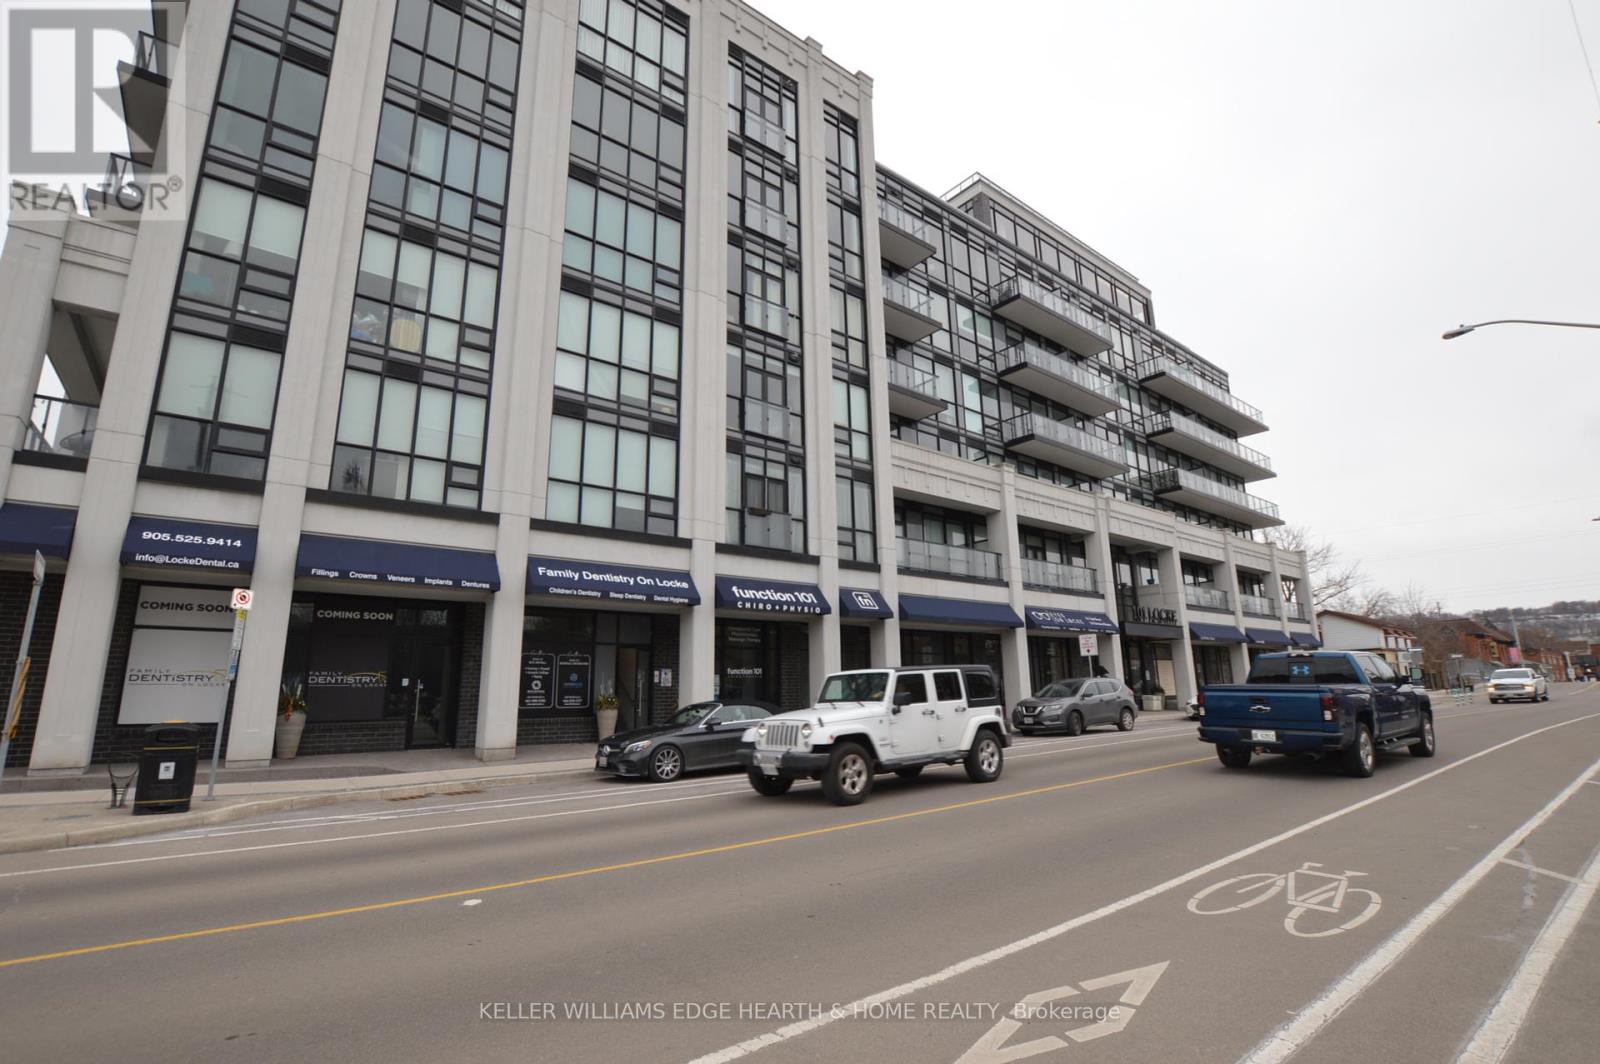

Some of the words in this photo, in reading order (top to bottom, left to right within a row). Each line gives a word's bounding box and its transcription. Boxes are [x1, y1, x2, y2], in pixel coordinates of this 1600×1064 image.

[142, 531, 242, 548] 905.525.9414
[135, 553, 239, 568] info@LockeDental.ca
[311, 568, 340, 578] Fillings
[349, 571, 378, 580] Crowns
[387, 574, 416, 583] Veneers
[424, 577, 453, 587] Implants
[461, 580, 490, 589] Dentures
[537, 567, 580, 581] Family
[582, 571, 635, 586] Dentistry
[636, 576, 655, 587] On
[656, 577, 690, 589] Locke
[549, 587, 577, 596] Children's
[578, 589, 602, 598] Dentistry
[624, 593, 647, 601] Dentistry
[732, 586, 798, 603] function
[796, 592, 819, 604] 101
[140, 600, 194, 612] COMING
[196, 602, 233, 614] SOON
[737, 601, 772, 611] CHIRO
[782, 605, 821, 614] PHYSIO
[317, 609, 361, 619] COMING
[363, 611, 393, 621] SOON
[728, 667, 753, 675] function
